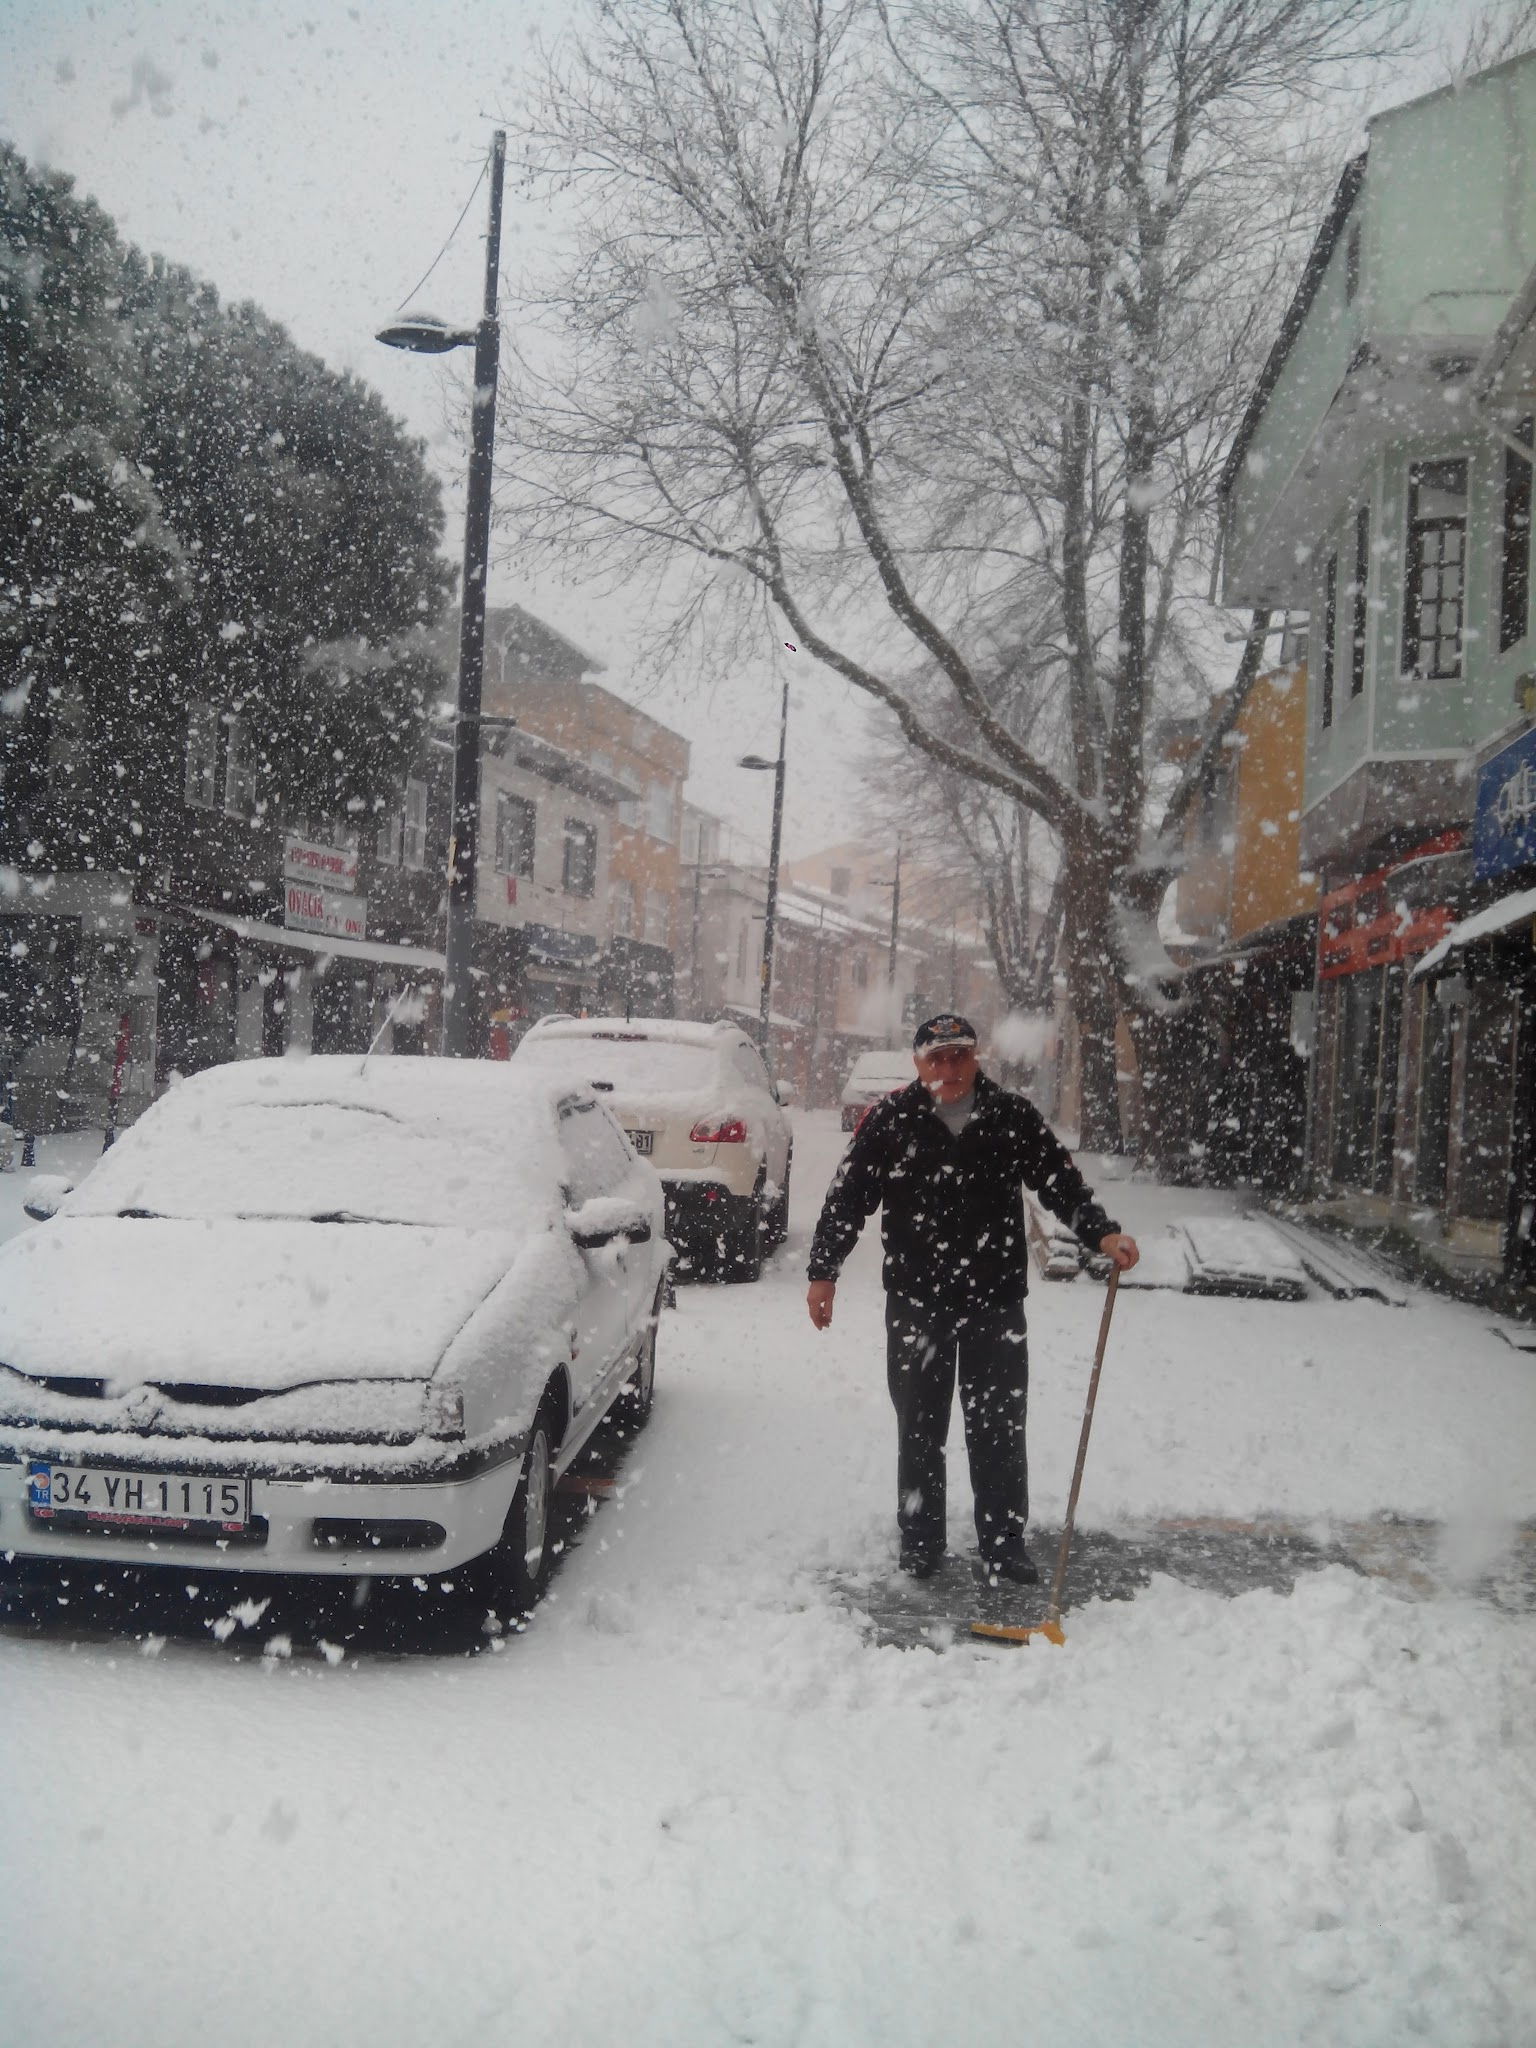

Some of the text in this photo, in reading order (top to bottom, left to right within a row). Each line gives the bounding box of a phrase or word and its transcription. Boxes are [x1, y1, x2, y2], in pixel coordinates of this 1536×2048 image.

[35, 1489, 49, 1500] TR
[53, 1472, 239, 1516] 34 YH 1115
